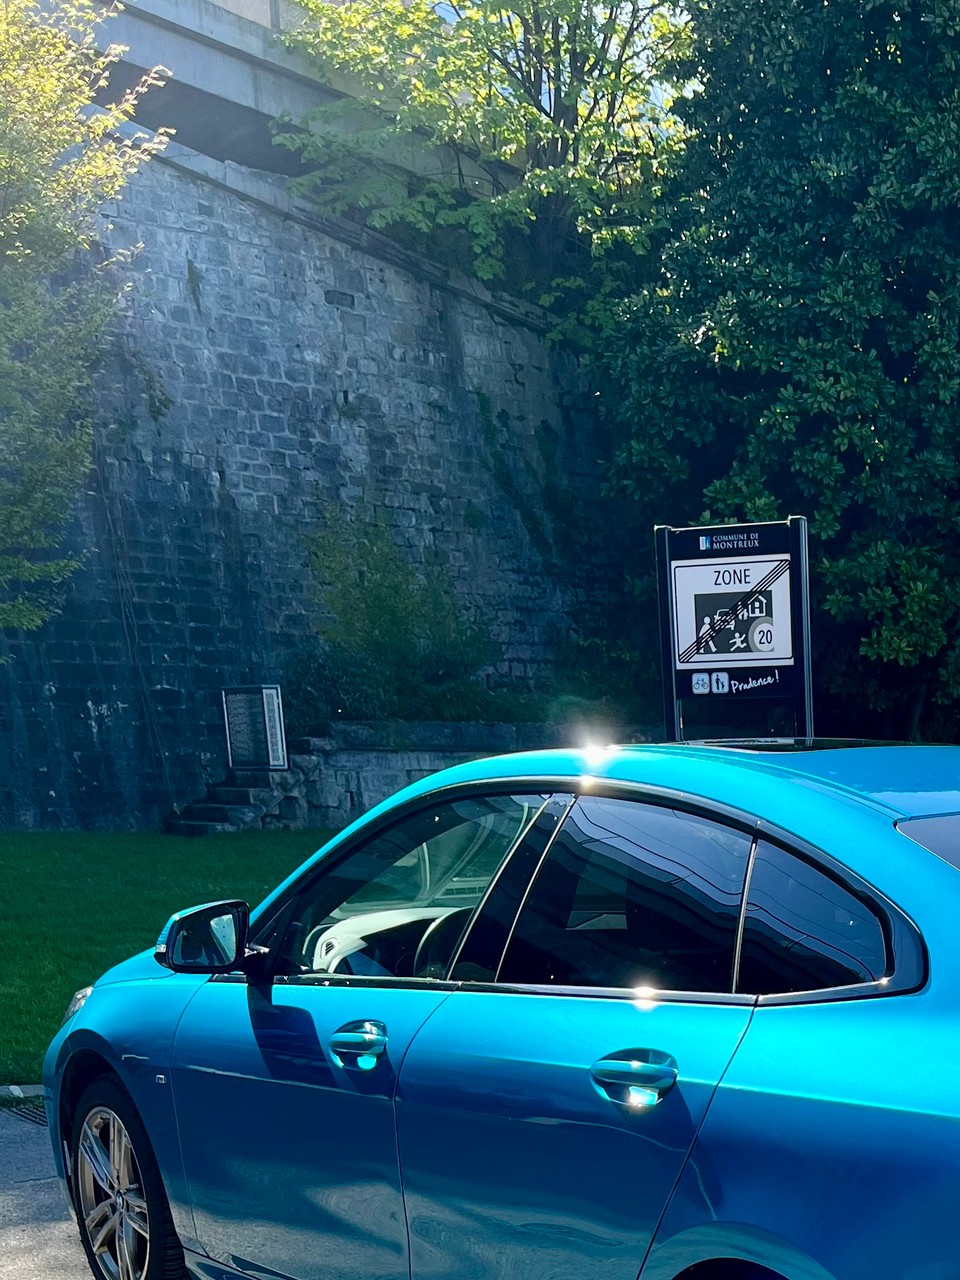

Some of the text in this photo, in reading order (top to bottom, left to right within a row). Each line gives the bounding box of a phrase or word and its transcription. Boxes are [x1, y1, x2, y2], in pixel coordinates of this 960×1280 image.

[712, 532, 759, 542] COMMUNE DE
[712, 540, 760, 550] MONTREUX
[713, 568, 751, 586] ZONE
[758, 629, 773, 645] 20
[730, 676, 775, 694] Prudence
